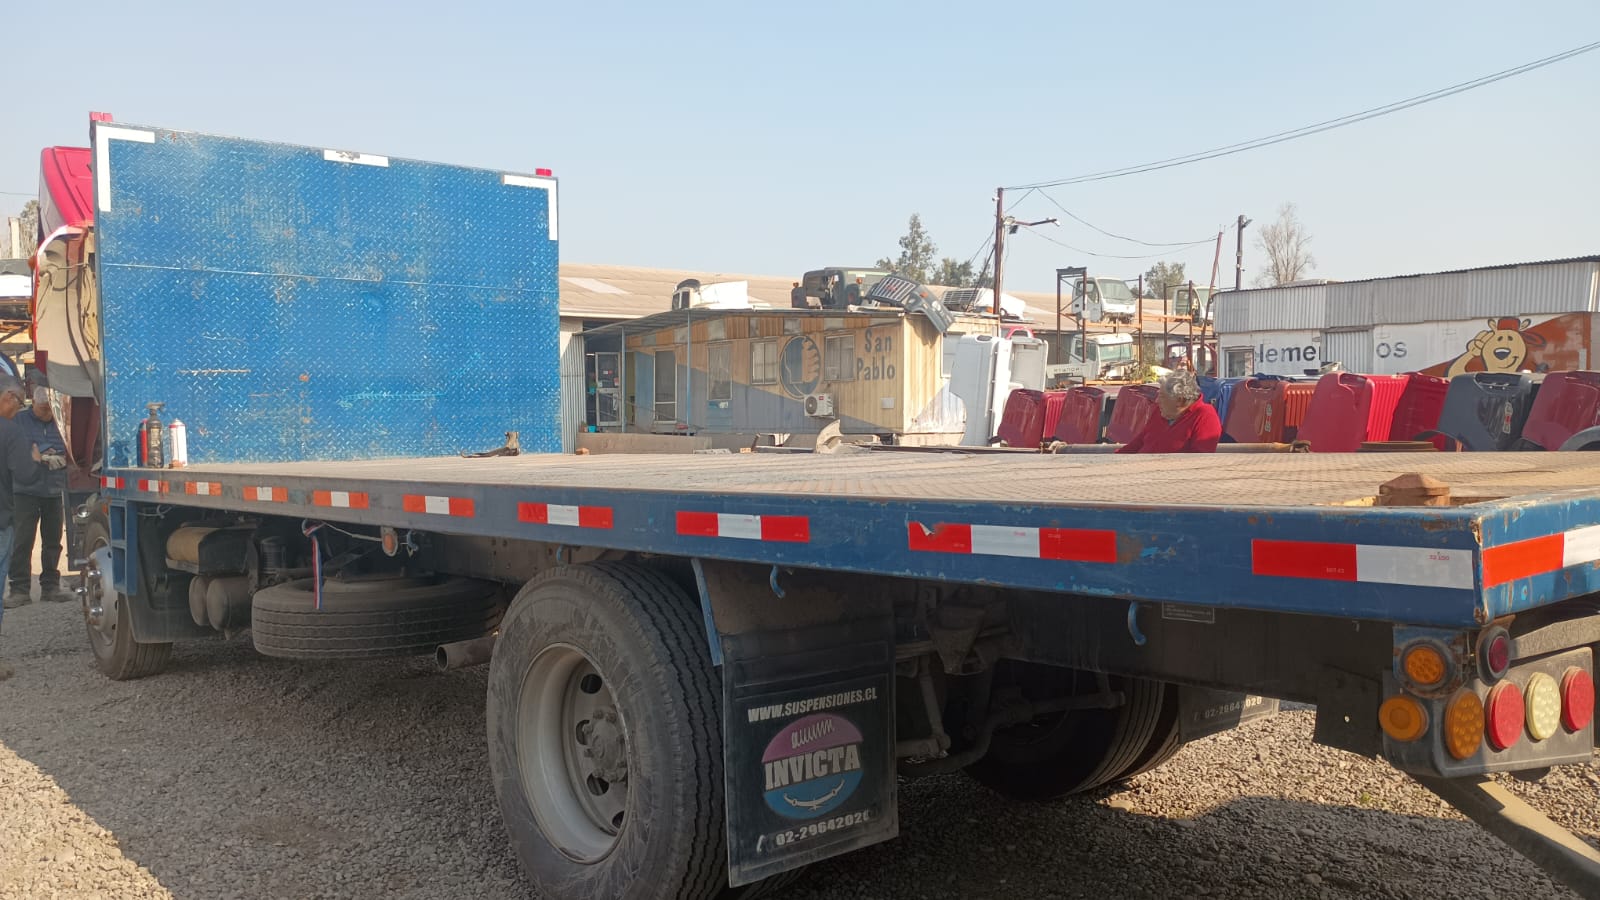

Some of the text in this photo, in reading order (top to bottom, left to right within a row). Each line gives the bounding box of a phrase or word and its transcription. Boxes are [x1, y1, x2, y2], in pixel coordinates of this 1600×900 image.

[865, 328, 892, 352] San
[1254, 344, 1321, 363] leme
[857, 355, 896, 381] Pablo
[747, 687, 878, 723] WWW.SUSPENSIONES.CL
[764, 744, 862, 791] INVICTA
